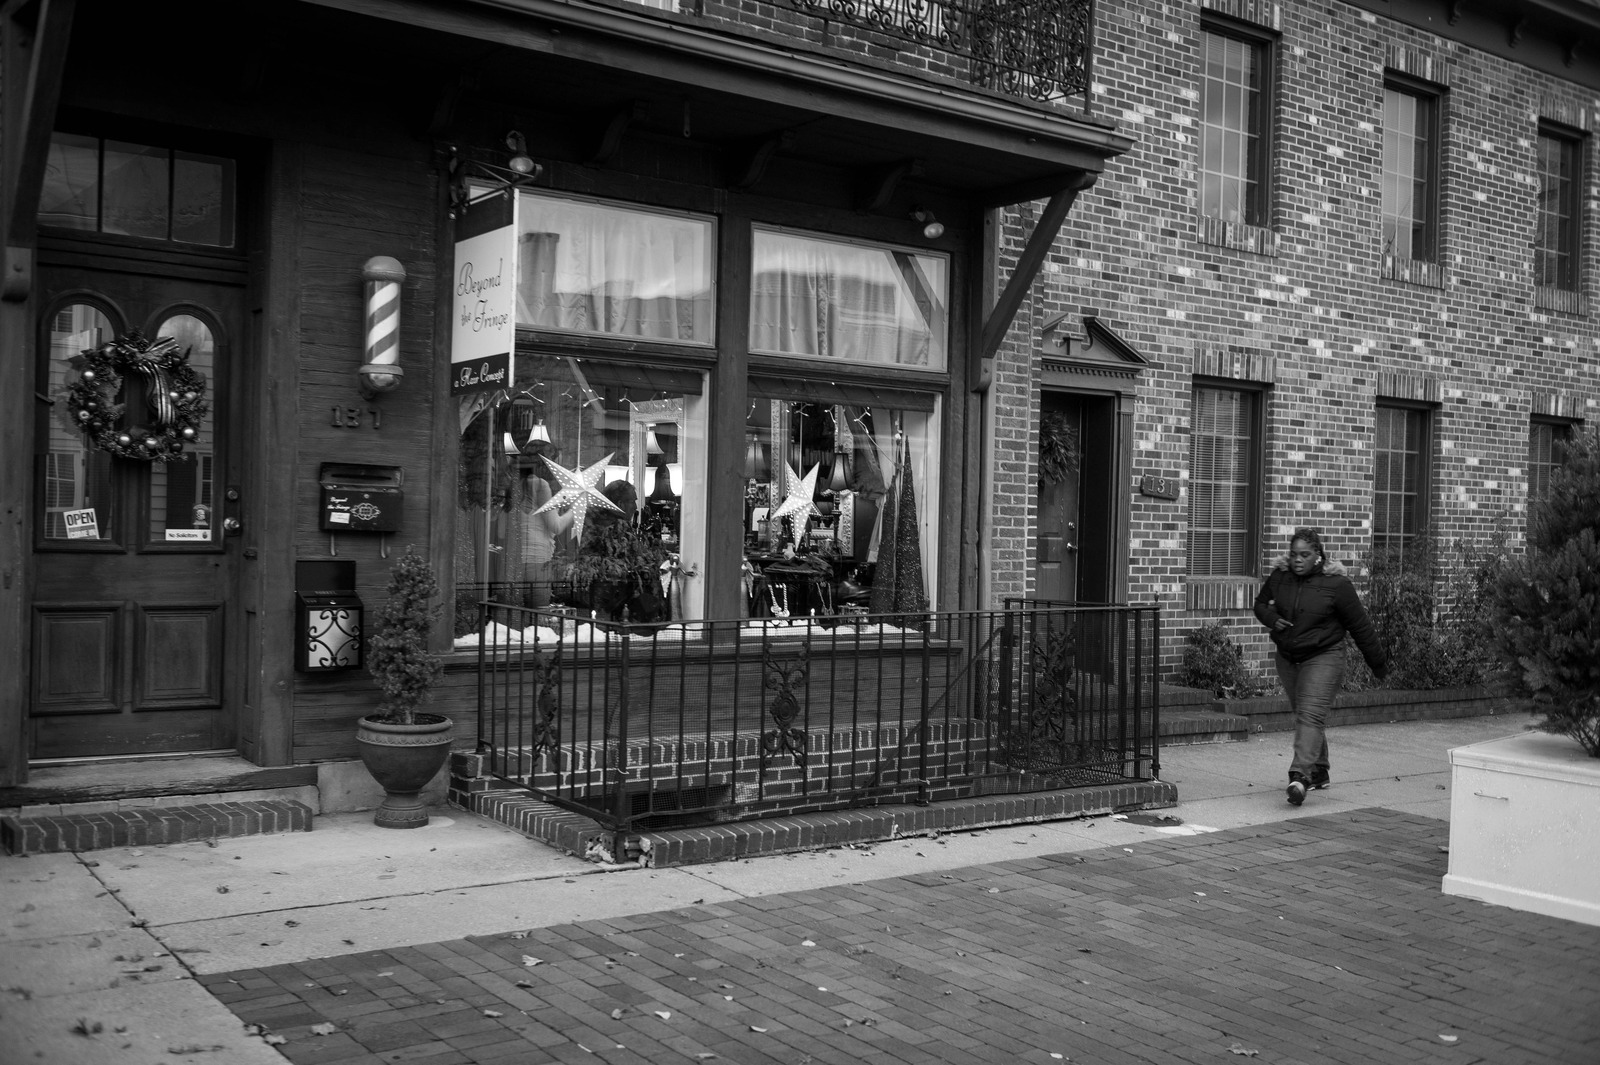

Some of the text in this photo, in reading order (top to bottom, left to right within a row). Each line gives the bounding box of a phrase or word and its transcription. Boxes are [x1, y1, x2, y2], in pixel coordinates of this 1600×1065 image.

[456, 258, 503, 298] Beyond
[461, 299, 508, 333] the Fringe
[331, 405, 382, 430] 137
[1147, 477, 1174, 496] 131
[66, 511, 95, 526] OPEN
